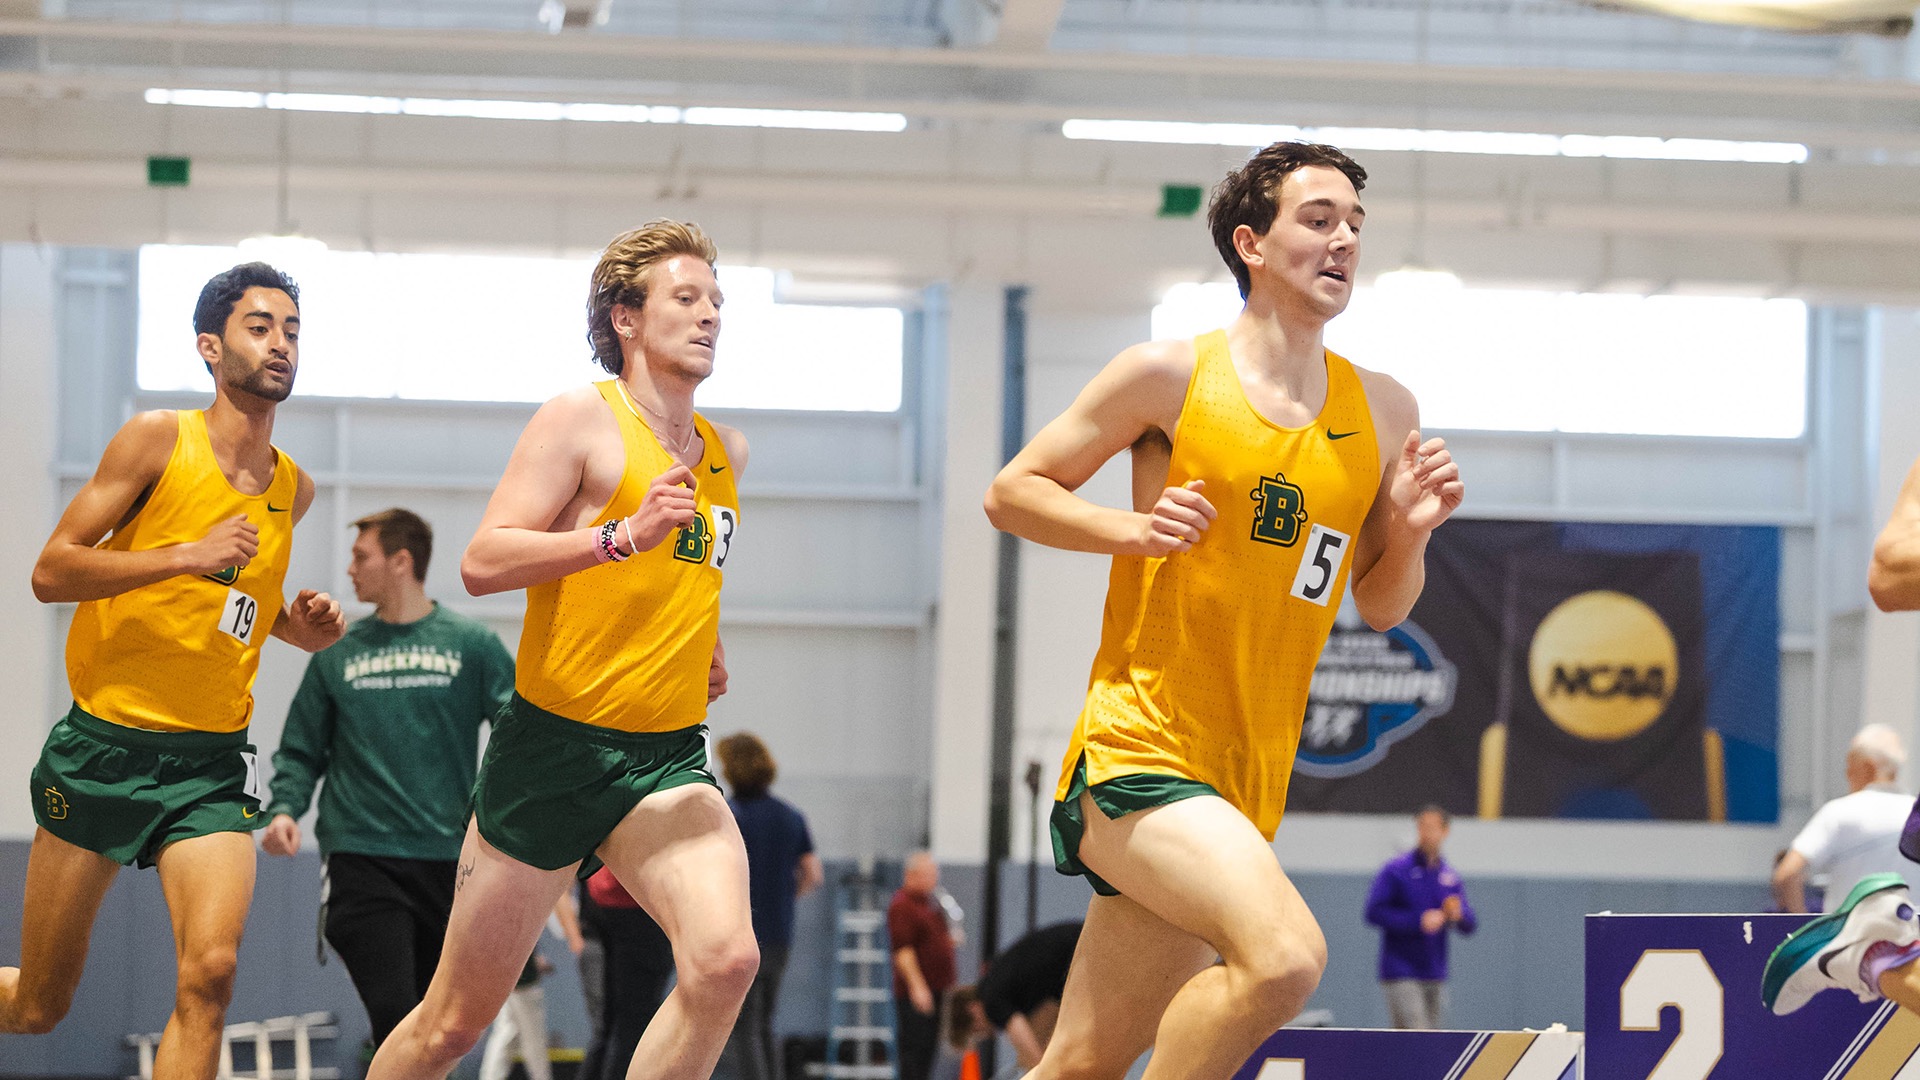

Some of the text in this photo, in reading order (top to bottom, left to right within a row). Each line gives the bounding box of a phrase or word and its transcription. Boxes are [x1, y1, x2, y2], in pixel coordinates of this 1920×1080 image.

[1250, 473, 1308, 548] B
[716, 511, 735, 568] 3
[1302, 532, 1343, 600] 5
[232, 595, 256, 639] 19
[343, 652, 462, 682] BROCKPORT
[1549, 662, 1665, 699] NCAA
[1620, 949, 1724, 1080] 2
